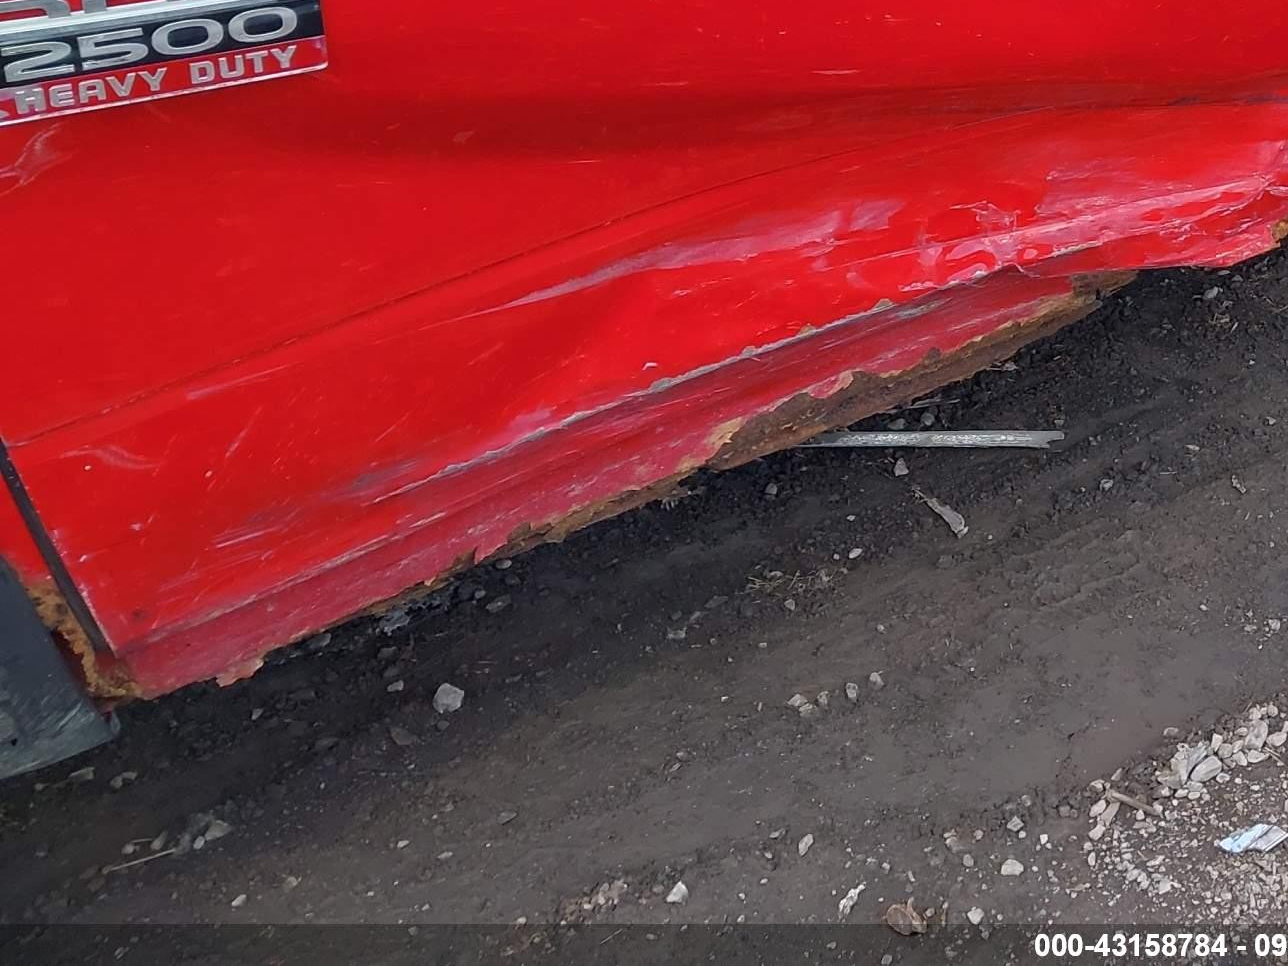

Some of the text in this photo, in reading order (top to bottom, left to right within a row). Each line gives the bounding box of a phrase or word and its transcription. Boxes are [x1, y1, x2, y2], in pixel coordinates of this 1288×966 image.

[1, 6, 298, 83] 2500
[14, 45, 297, 115] HEAVY DUTY
